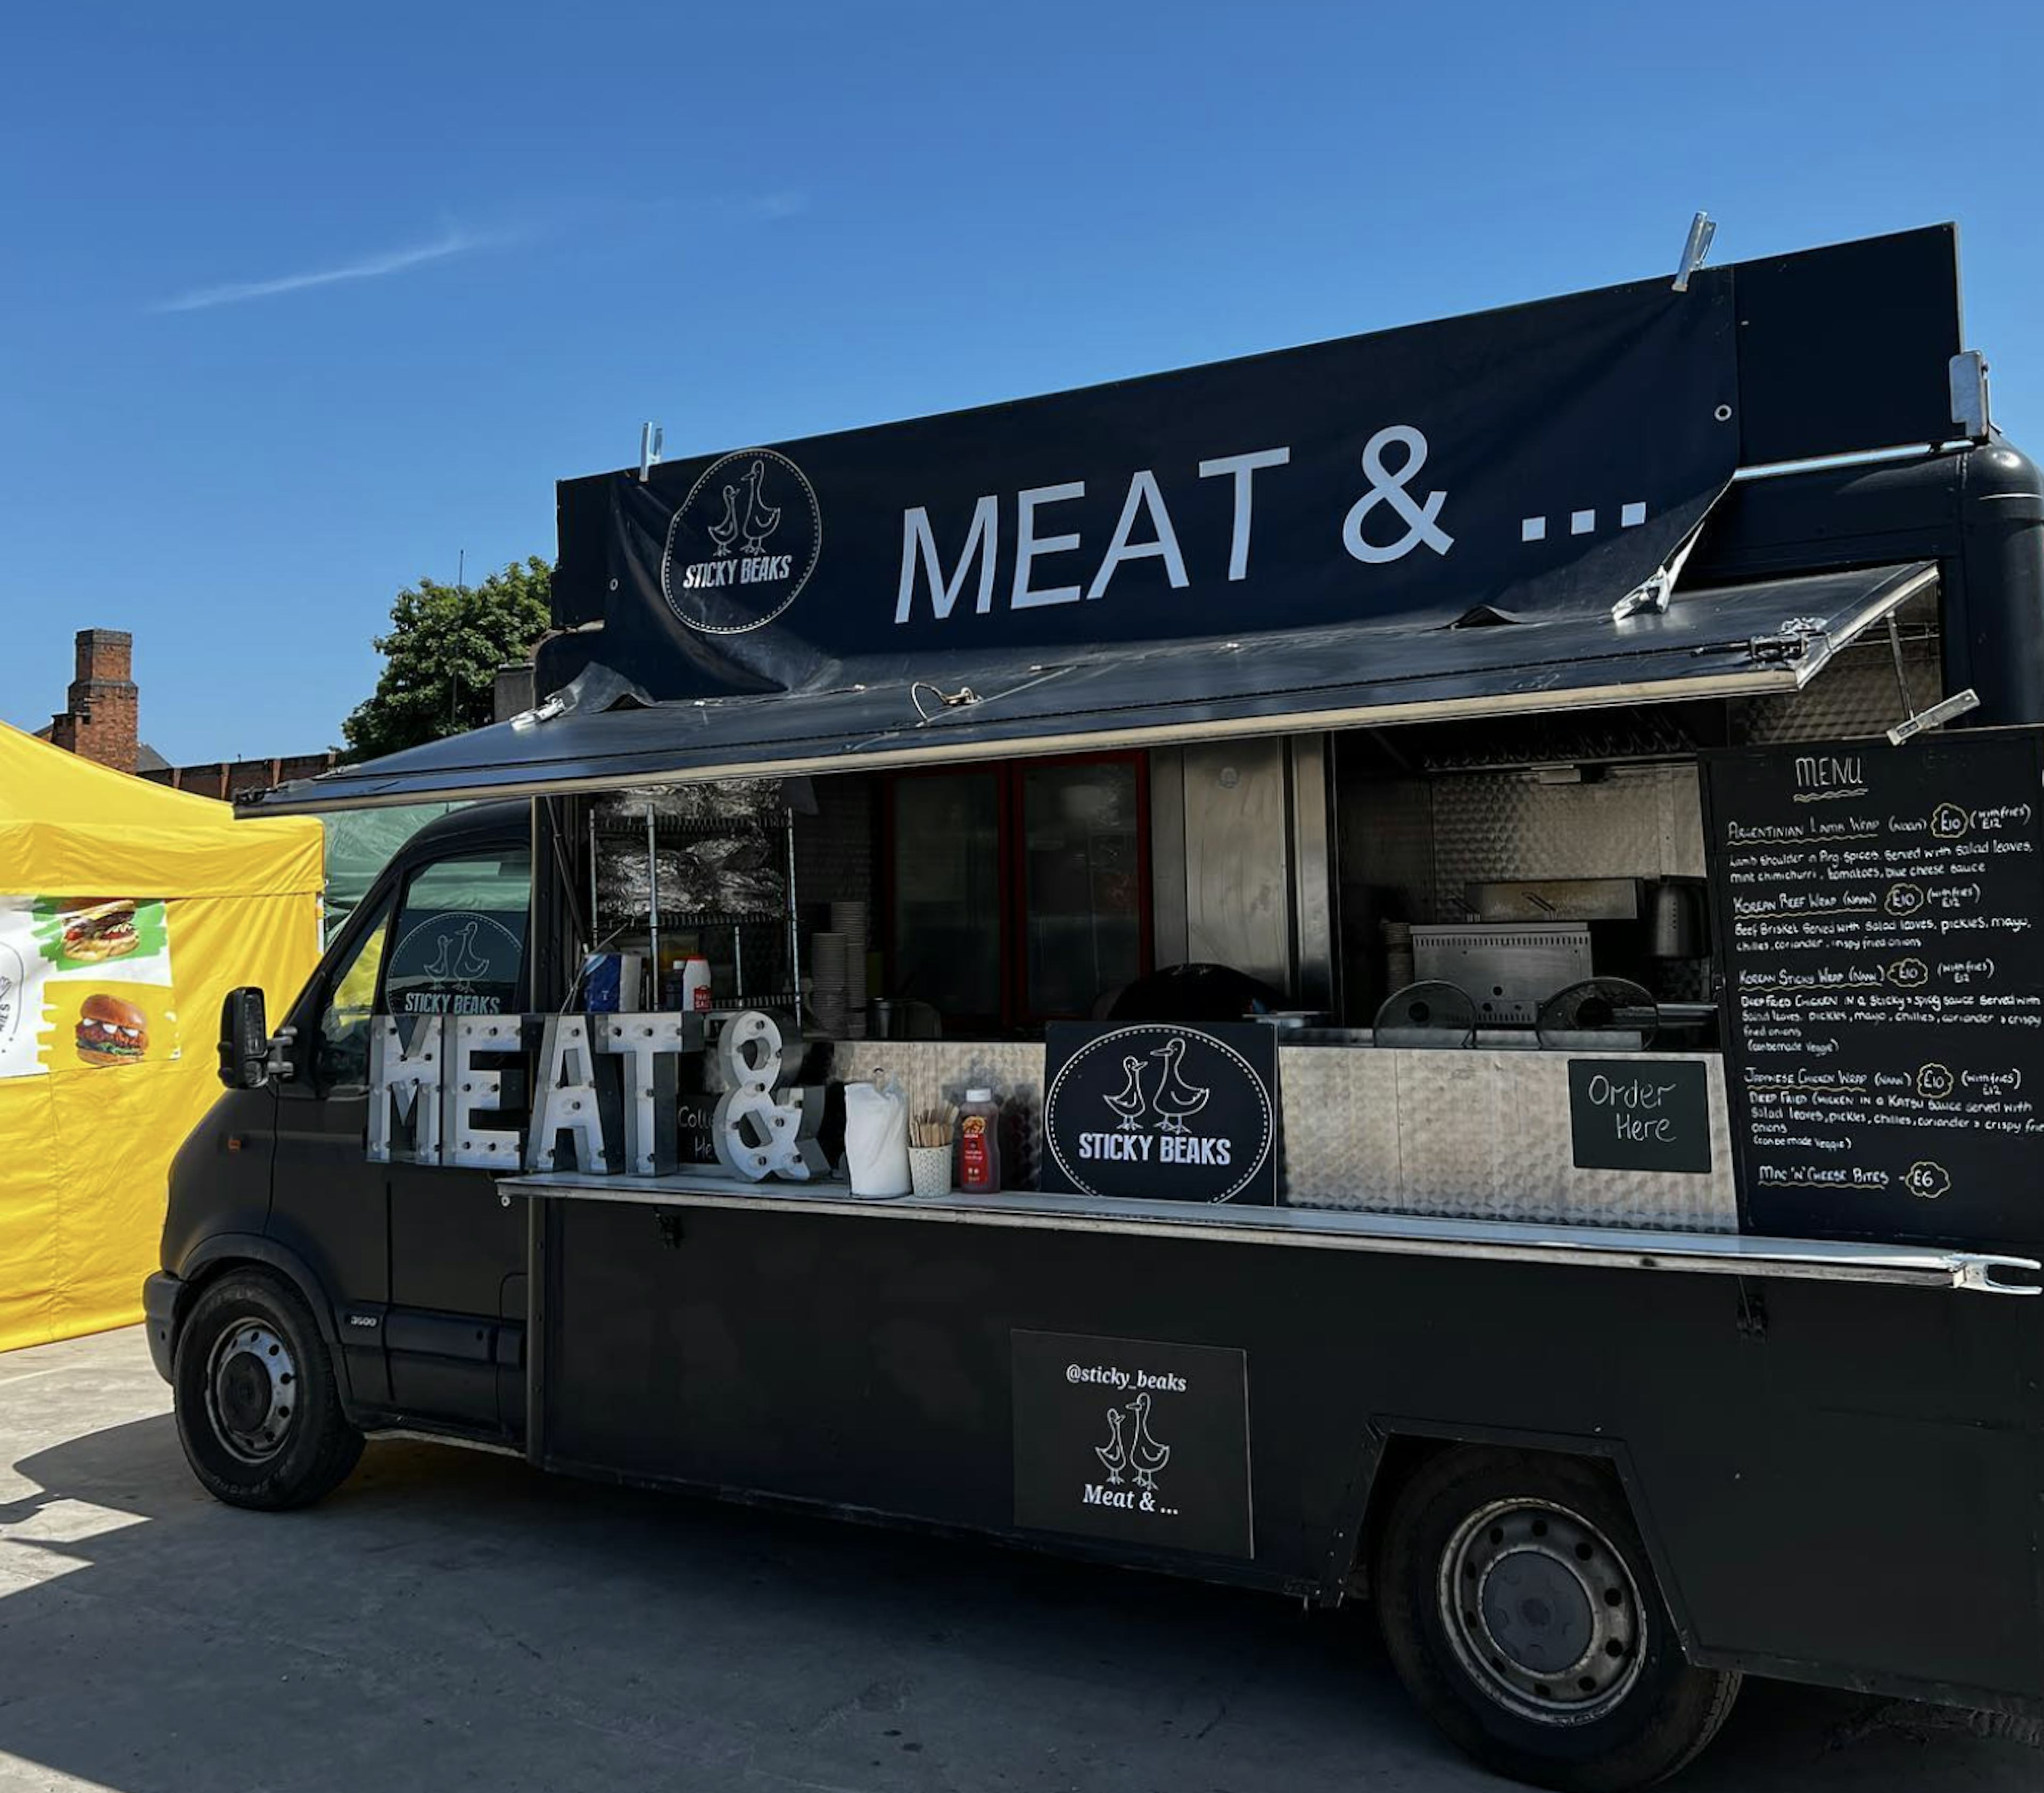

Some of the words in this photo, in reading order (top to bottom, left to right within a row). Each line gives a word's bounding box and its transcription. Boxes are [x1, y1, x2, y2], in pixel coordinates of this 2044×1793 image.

[895, 447, 1290, 623] MEAT
[1342, 425, 1454, 564] &
[683, 559, 738, 588] STICKY
[740, 555, 793, 584] BEAKS
[1795, 757, 1863, 786] MENU
[405, 993, 451, 1013] STICKY
[454, 994, 500, 1014] BEAKS
[366, 1010, 692, 1178] MEAT
[712, 1010, 817, 1183] &
[1588, 1075, 1677, 1108] Order
[1617, 1113, 1677, 1142] Here
[1078, 1133, 1153, 1162] STICKY
[1160, 1136, 1232, 1165] BEAKS
[1066, 1363, 1187, 1392] @sticky_beaks
[1083, 1484, 1134, 1509] Meat
[1140, 1491, 1156, 1512] &
